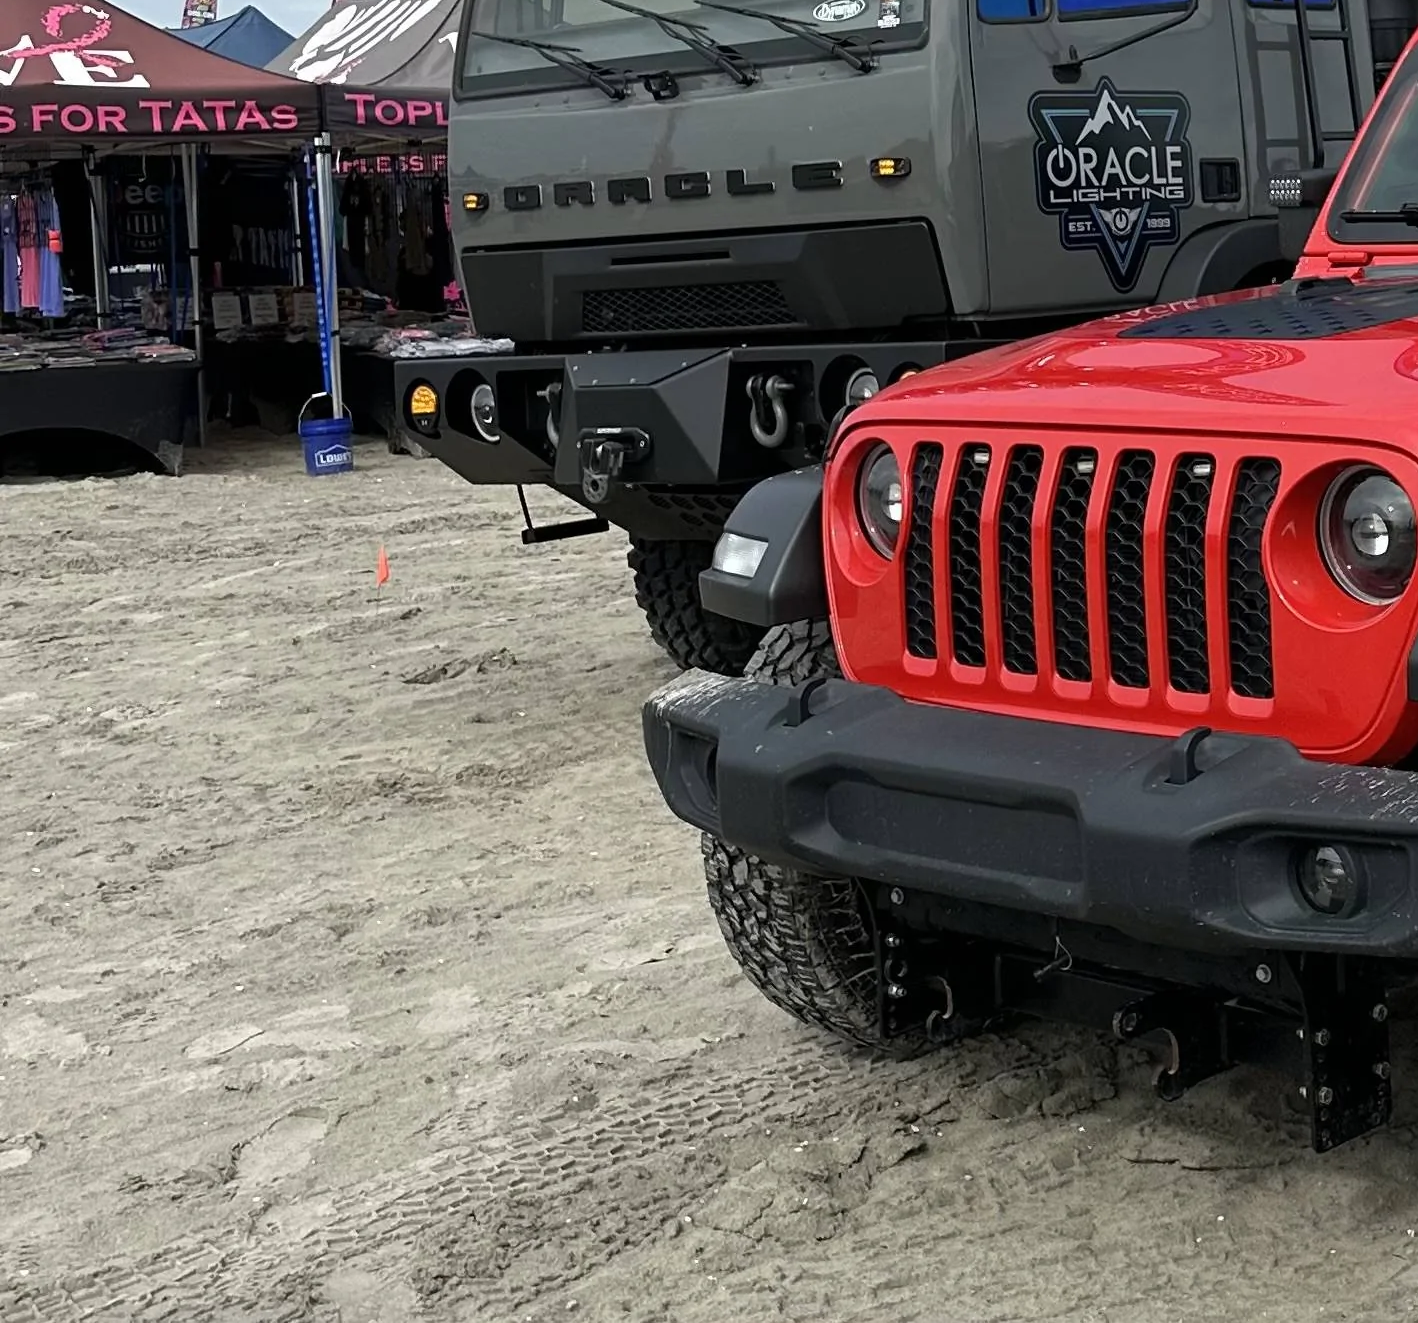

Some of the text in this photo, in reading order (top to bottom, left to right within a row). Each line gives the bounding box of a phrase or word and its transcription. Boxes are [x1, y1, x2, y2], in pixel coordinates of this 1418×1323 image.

[31, 103, 128, 132] FOR
[138, 99, 298, 132] TATAS
[1046, 144, 1184, 188] ORACLE
[503, 159, 844, 211] ORACLE
[1050, 186, 1185, 204] LIGHTING
[1068, 221, 1097, 233] EST.
